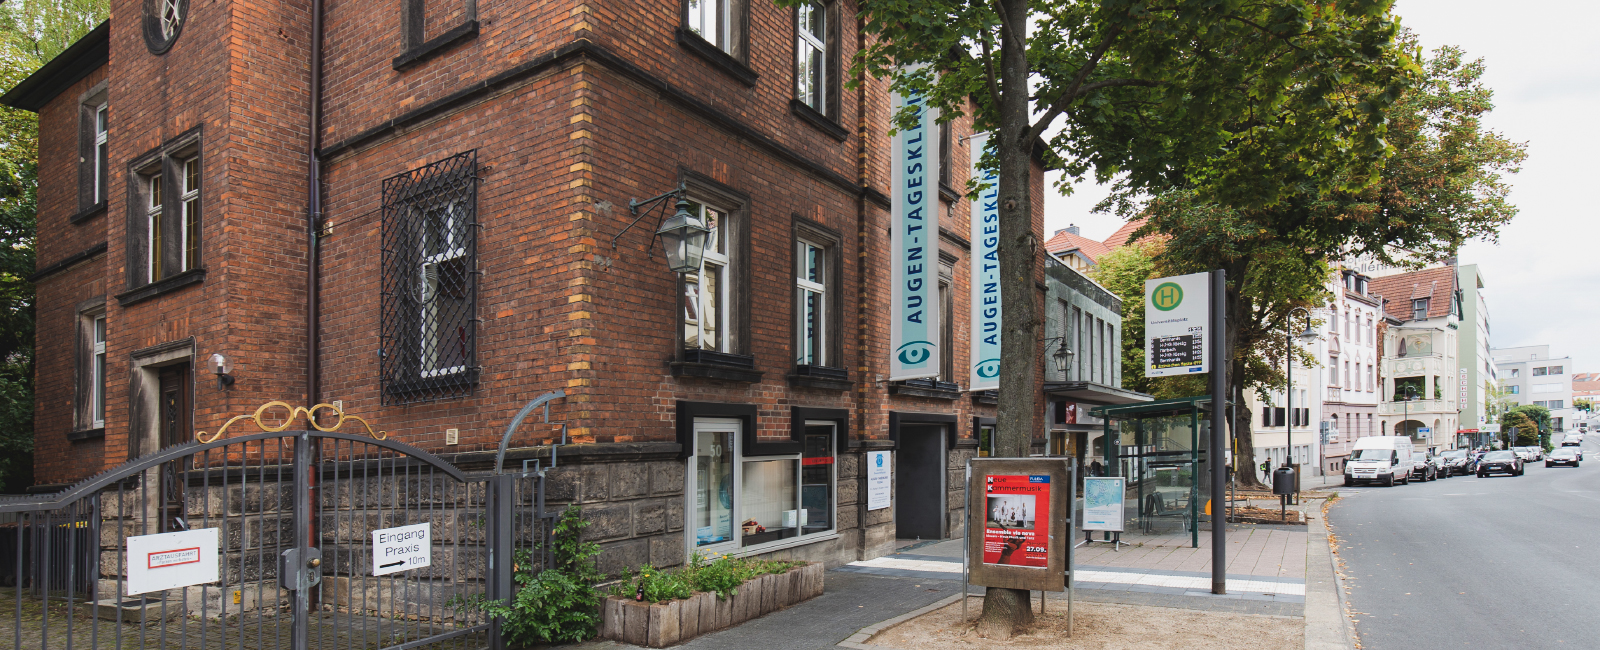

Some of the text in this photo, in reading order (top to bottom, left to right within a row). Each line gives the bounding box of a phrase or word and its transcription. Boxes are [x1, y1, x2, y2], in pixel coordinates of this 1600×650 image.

[983, 150, 998, 345] AUGEN-TAGESKLN
[1161, 288, 1174, 306] H
[710, 444, 722, 457] 50
[987, 484, 1042, 492] Kammermusik
[379, 529, 425, 543] Eingang
[151, 550, 197, 561] ARZTAUSFAHRT
[385, 543, 420, 557] Praxis
[1026, 545, 1047, 553] 27.09.
[408, 556, 426, 565] 10m
